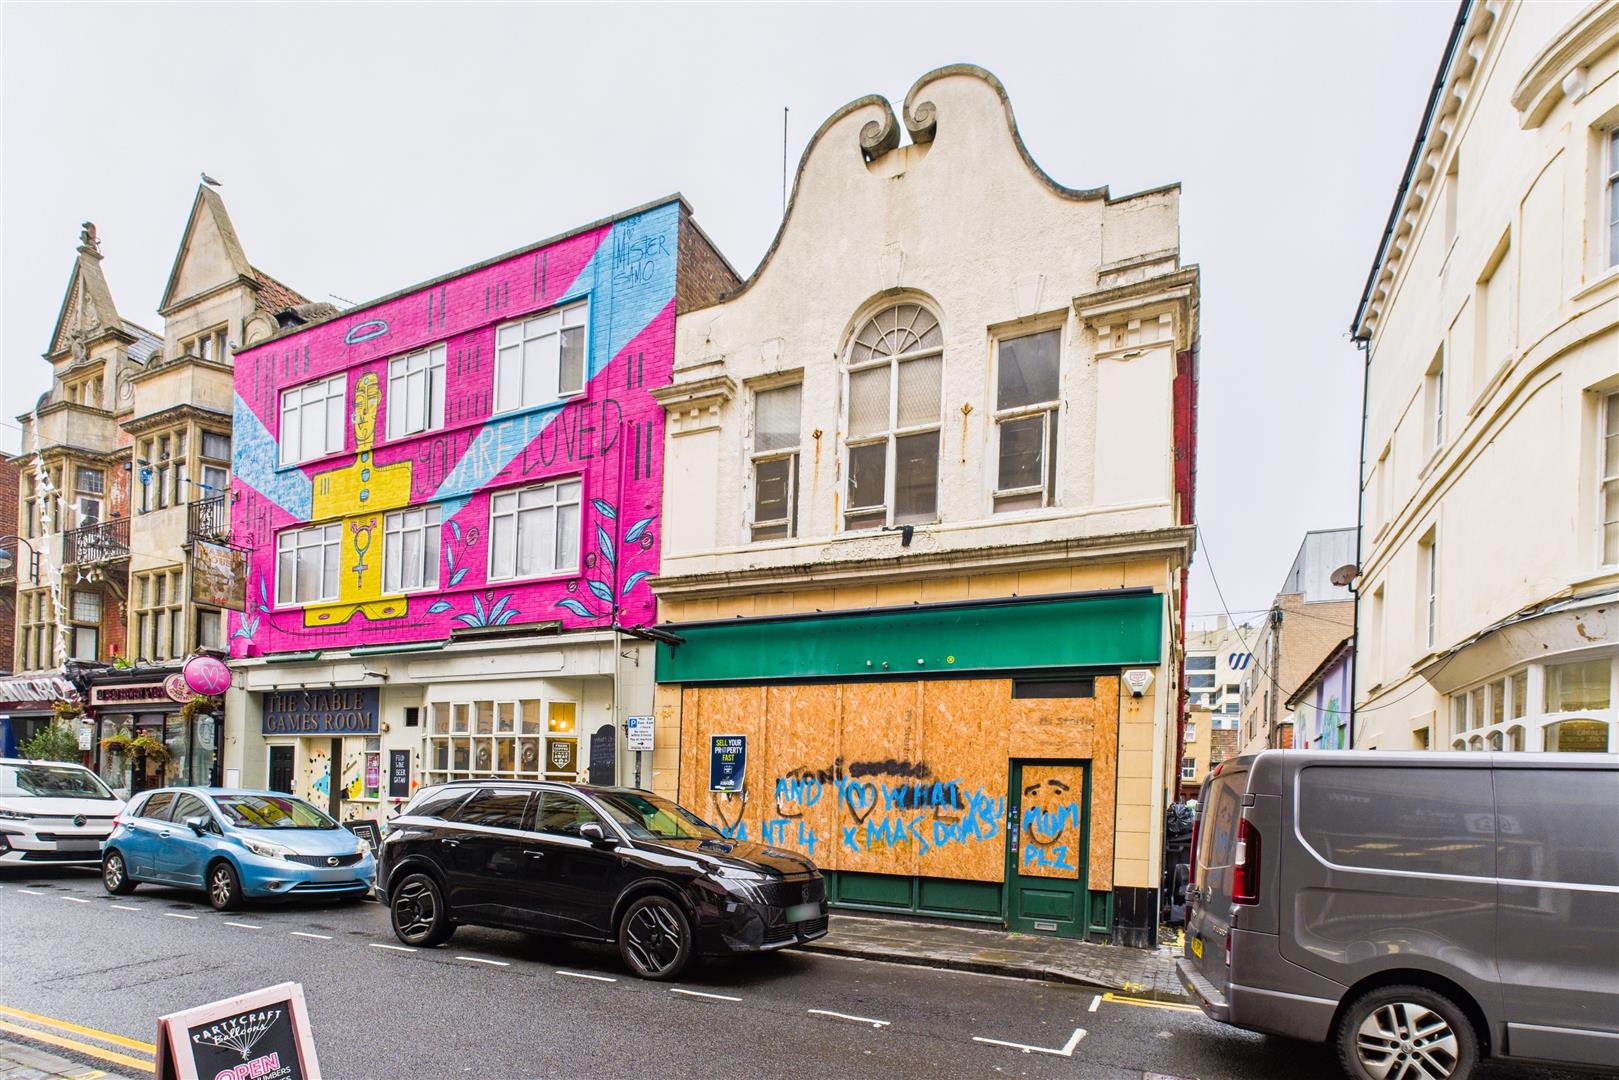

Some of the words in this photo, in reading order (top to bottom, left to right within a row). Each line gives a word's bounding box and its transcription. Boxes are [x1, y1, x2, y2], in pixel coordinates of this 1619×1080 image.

[416, 430, 458, 495] YOU
[459, 421, 513, 490] ARE
[522, 398, 622, 476] LOVED
[268, 695, 297, 713] THE
[303, 690, 364, 712] STABLE
[266, 713, 319, 731] GAMES
[324, 711, 372, 731] ROOM
[716, 739, 728, 747] SELL
[728, 739, 742, 747] YOUR
[722, 754, 735, 762] FAST
[775, 777, 822, 807] AND
[881, 777, 963, 812] WHAT
[1022, 801, 1079, 837] MUM
[798, 820, 818, 856] 4
[1024, 843, 1075, 871] PLZ
[192, 1010, 282, 1043] PARTYCRAFT
[213, 1023, 268, 1045] Balloons
[215, 1051, 281, 1080] OPEN
